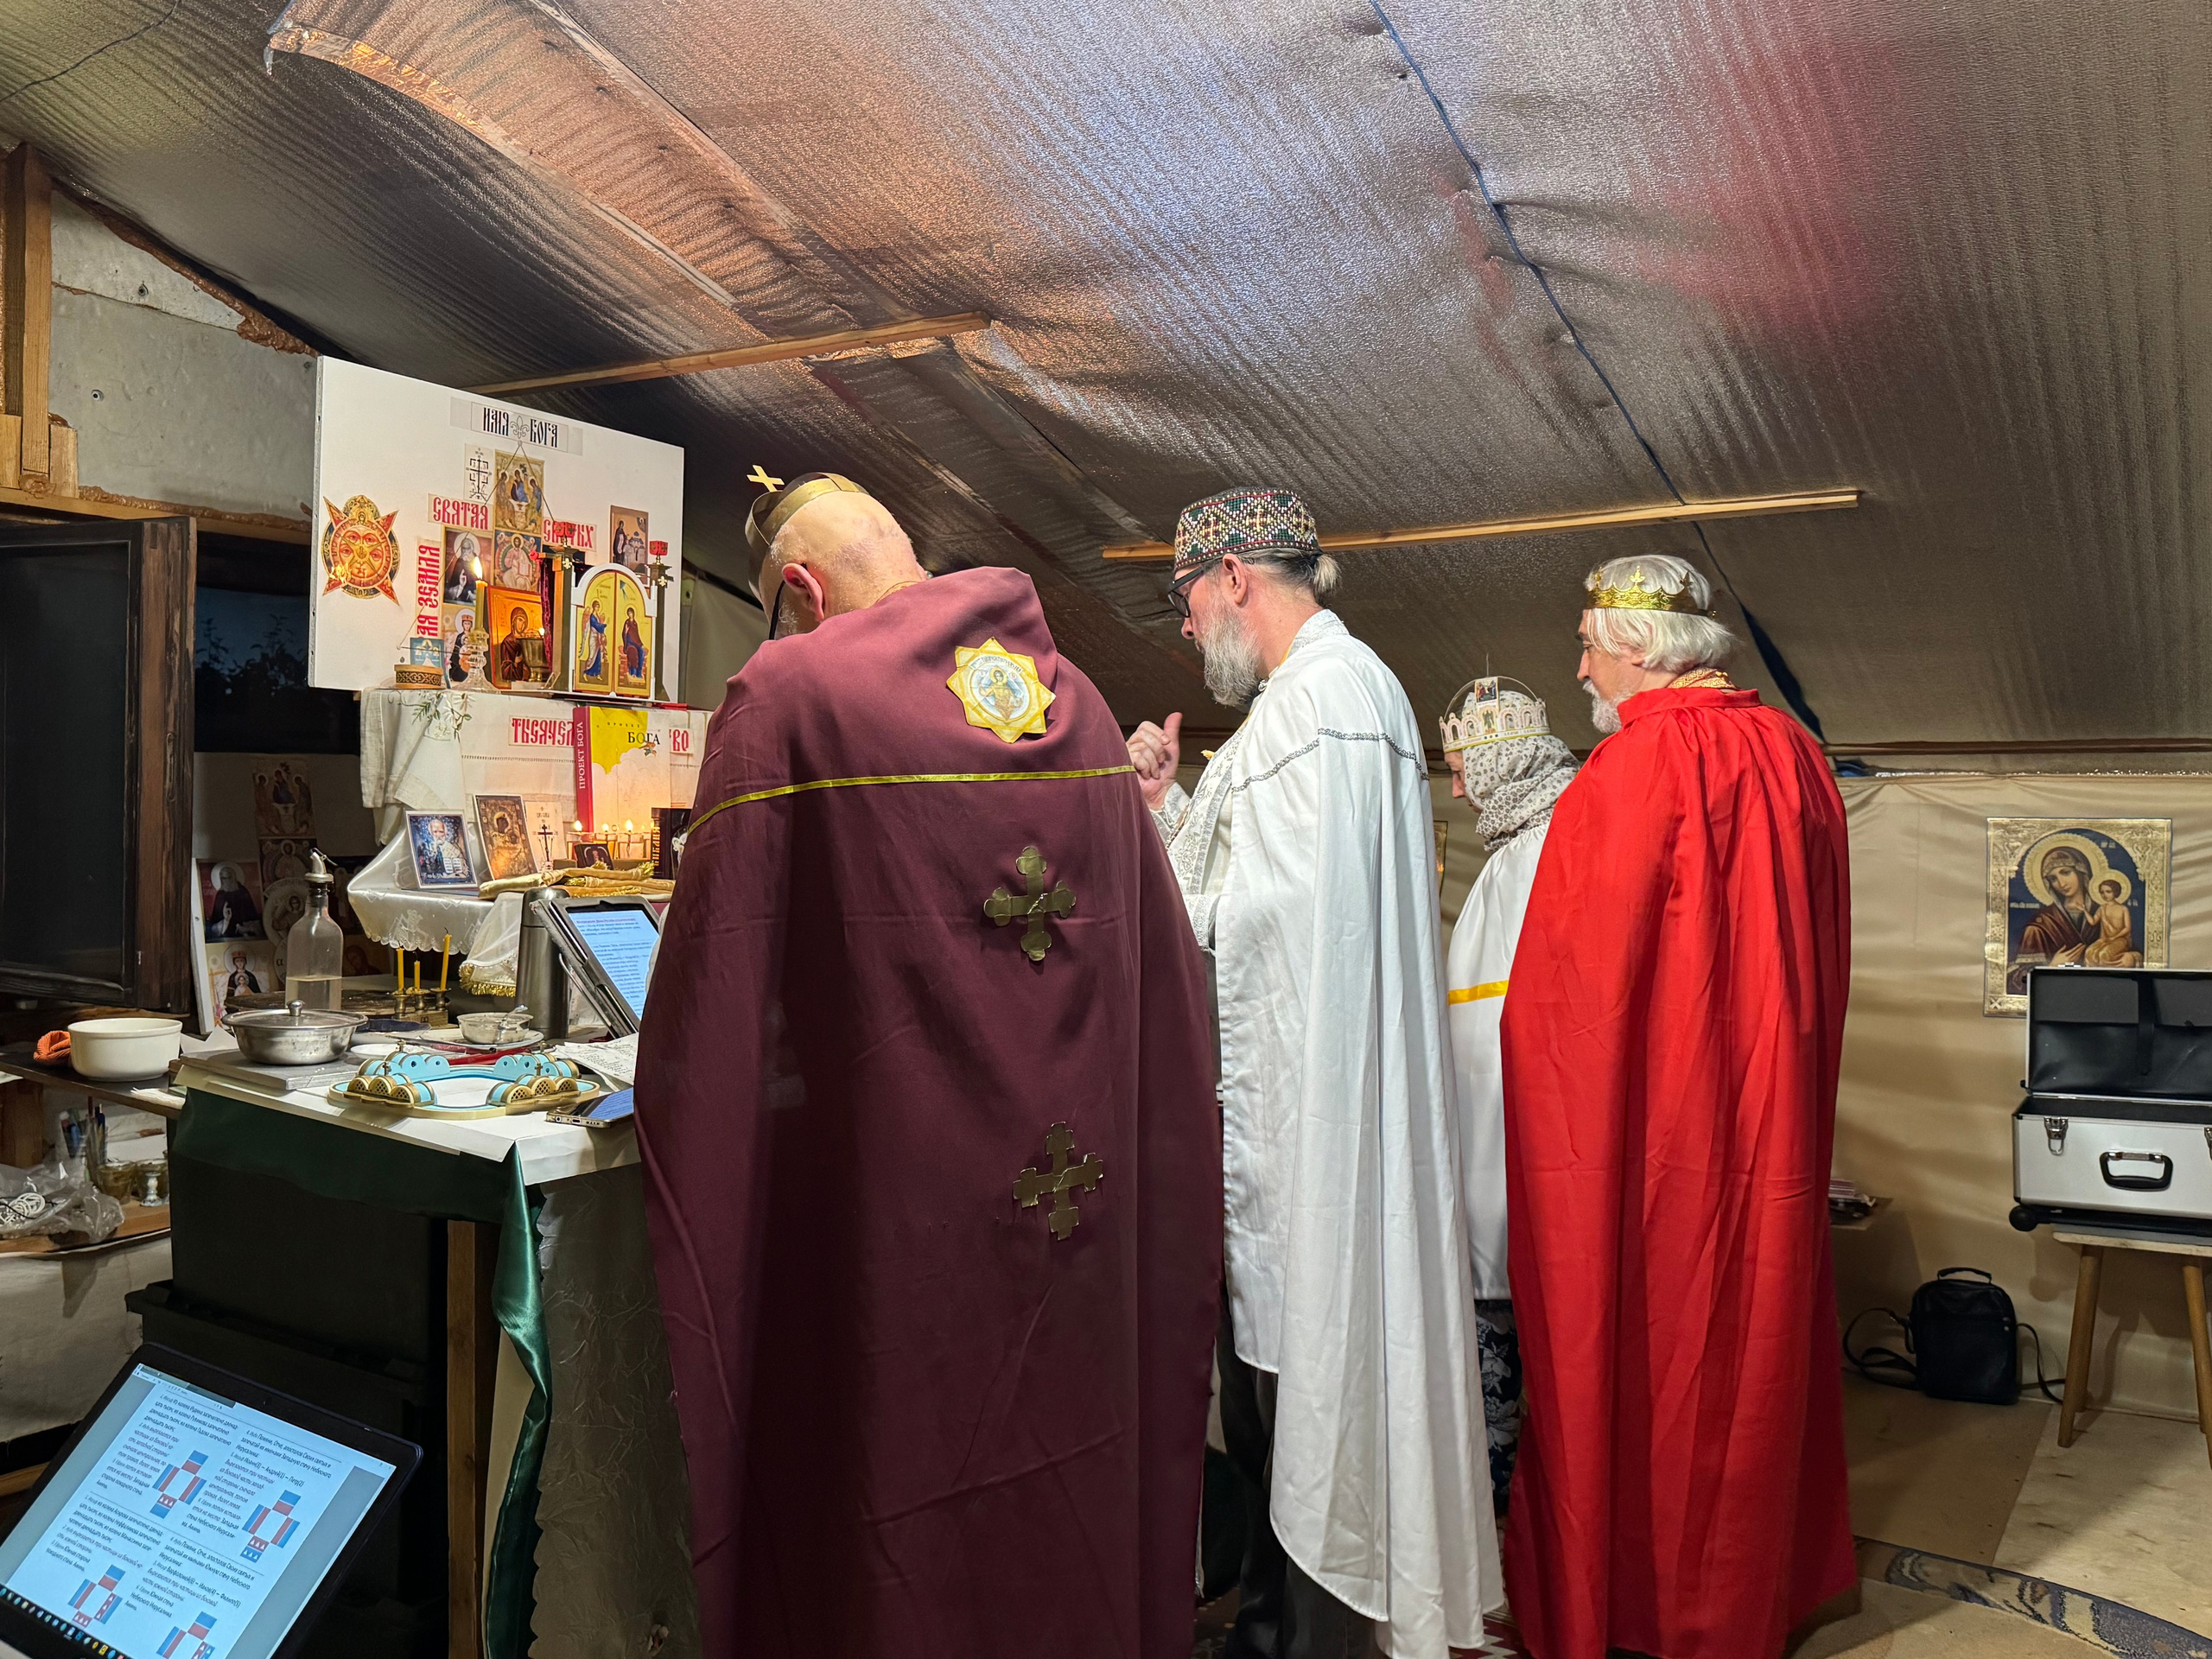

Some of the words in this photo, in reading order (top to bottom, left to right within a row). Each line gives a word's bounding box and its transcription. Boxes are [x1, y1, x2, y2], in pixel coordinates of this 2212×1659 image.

[482, 407, 510, 436] ИМЯ
[530, 418, 558, 448] БОГА
[433, 496, 489, 530] СВЯТАЯ
[417, 544, 441, 608] ЗЕМЛЯ
[576, 721, 585, 747] БОГА
[627, 731, 661, 745] БОГА
[578, 749, 587, 790] ПРОЕКТ
